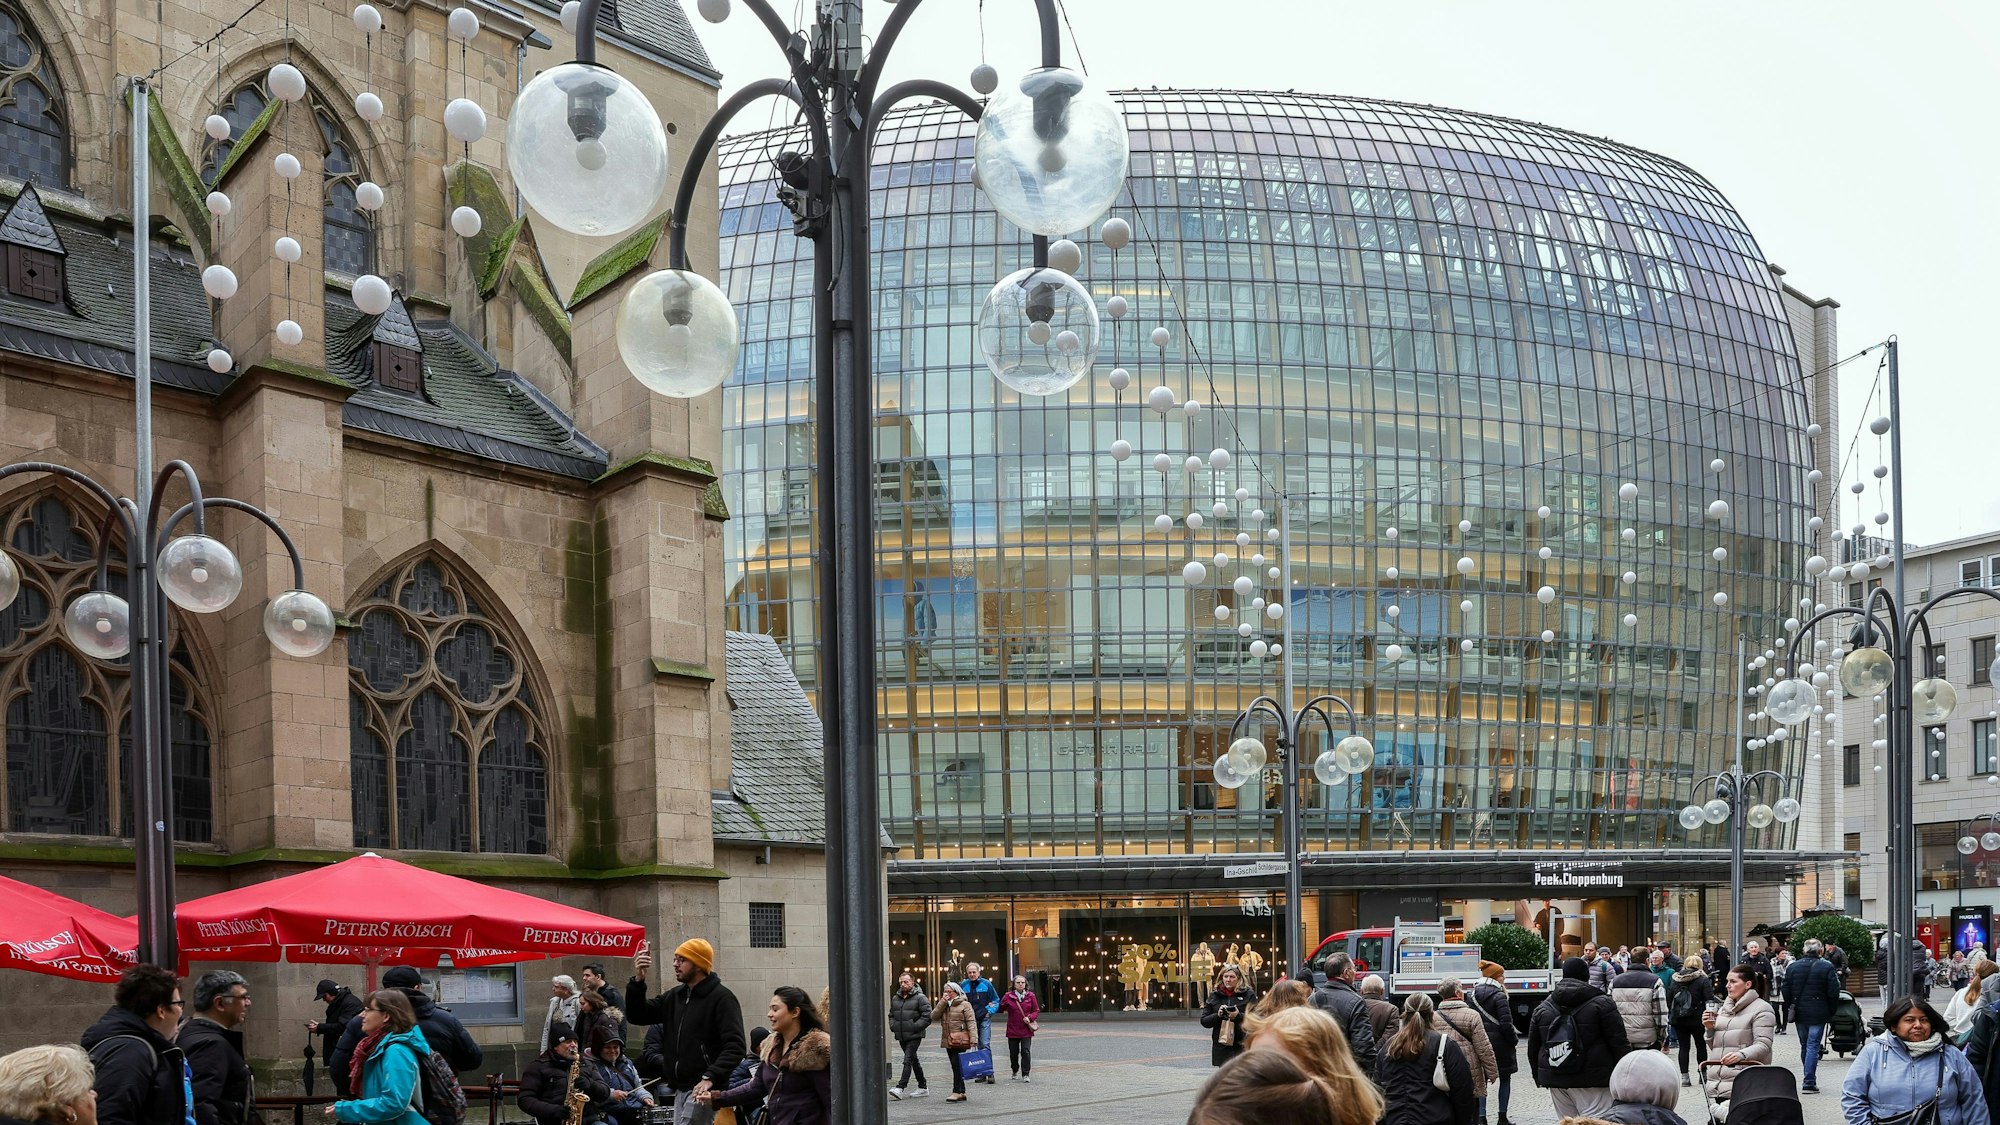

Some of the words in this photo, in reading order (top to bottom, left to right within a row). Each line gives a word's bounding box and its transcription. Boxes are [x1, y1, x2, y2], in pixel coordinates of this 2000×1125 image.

[1257, 863, 1286, 873] Schildergasse
[197, 920, 230, 937] PETERS
[230, 918, 267, 935] KÖLSCH
[324, 919, 390, 937] PETERS
[391, 921, 453, 938] KÖLSCH
[523, 927, 579, 944] PETERS
[580, 931, 632, 947] KÖLSCH
[1121, 943, 1178, 960] 50%
[1117, 960, 1213, 983] SALE
[1549, 1041, 1570, 1060] NIKE
